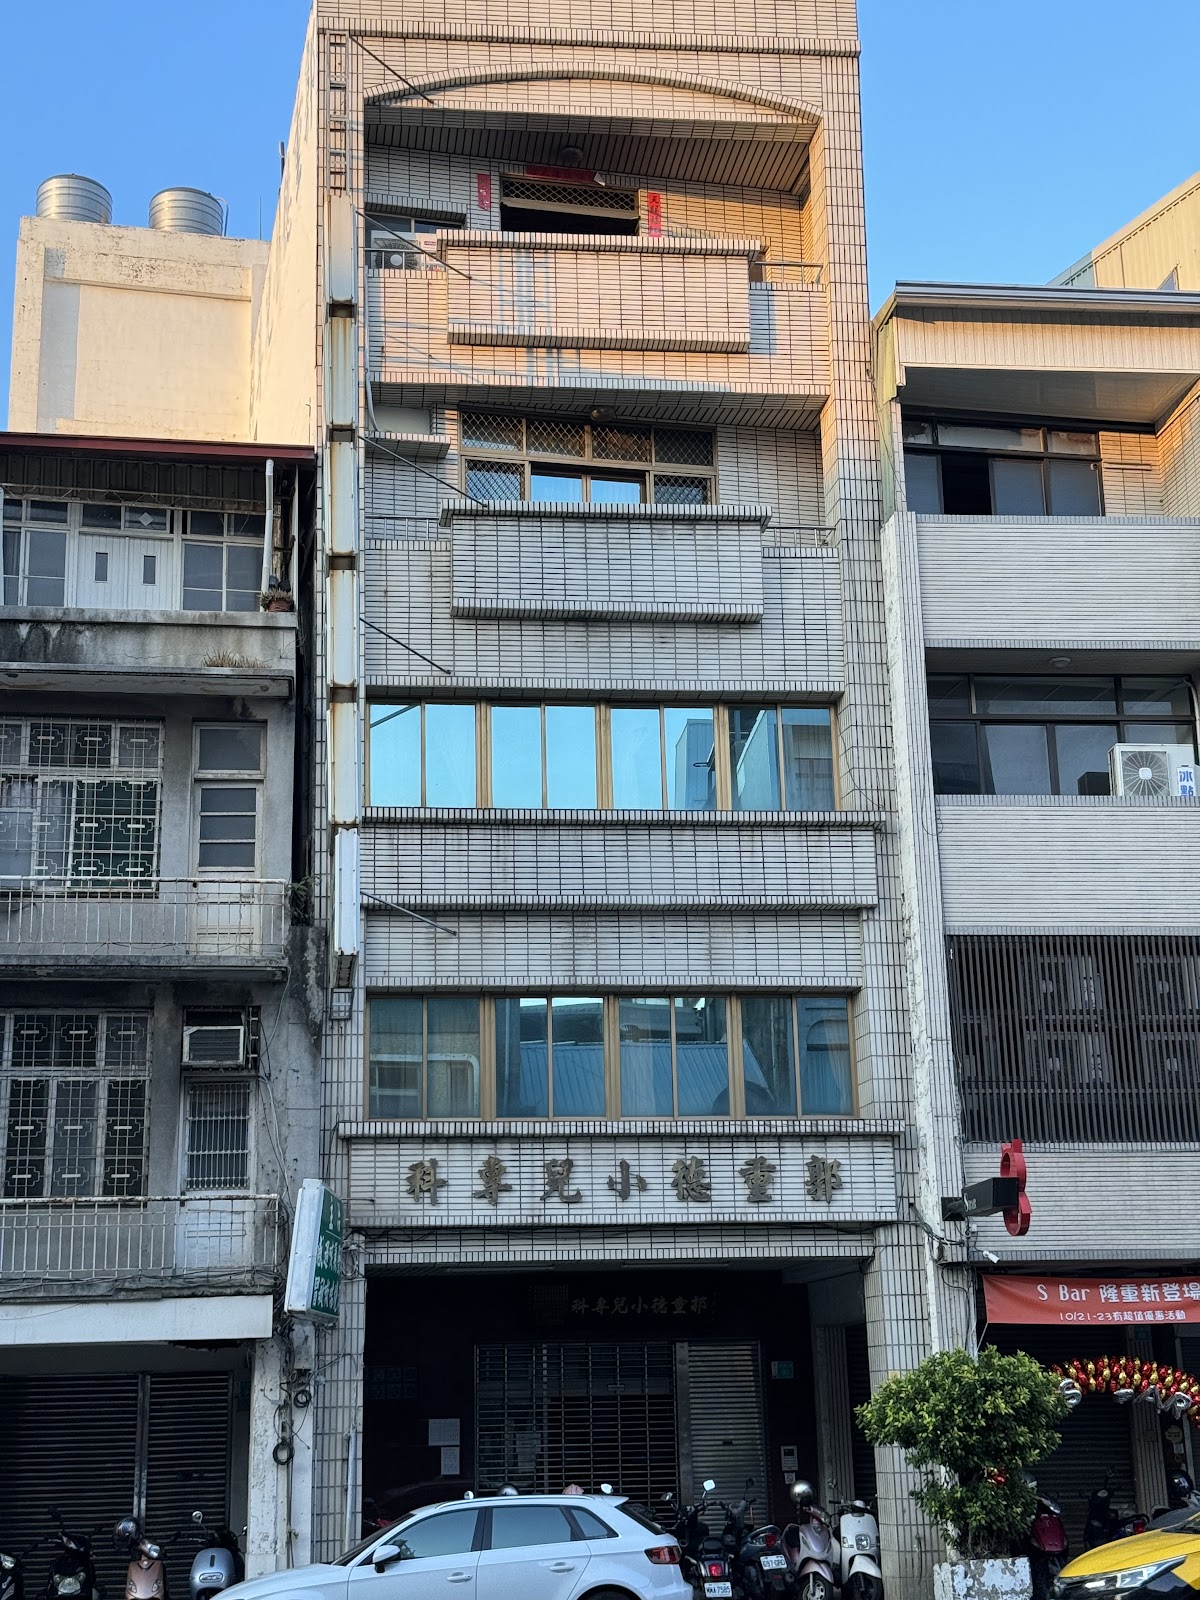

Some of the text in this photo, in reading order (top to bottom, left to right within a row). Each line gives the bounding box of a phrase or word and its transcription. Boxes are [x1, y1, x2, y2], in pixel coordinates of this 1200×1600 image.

[1036, 1282, 1200, 1303] S Bar 隆重新登場
